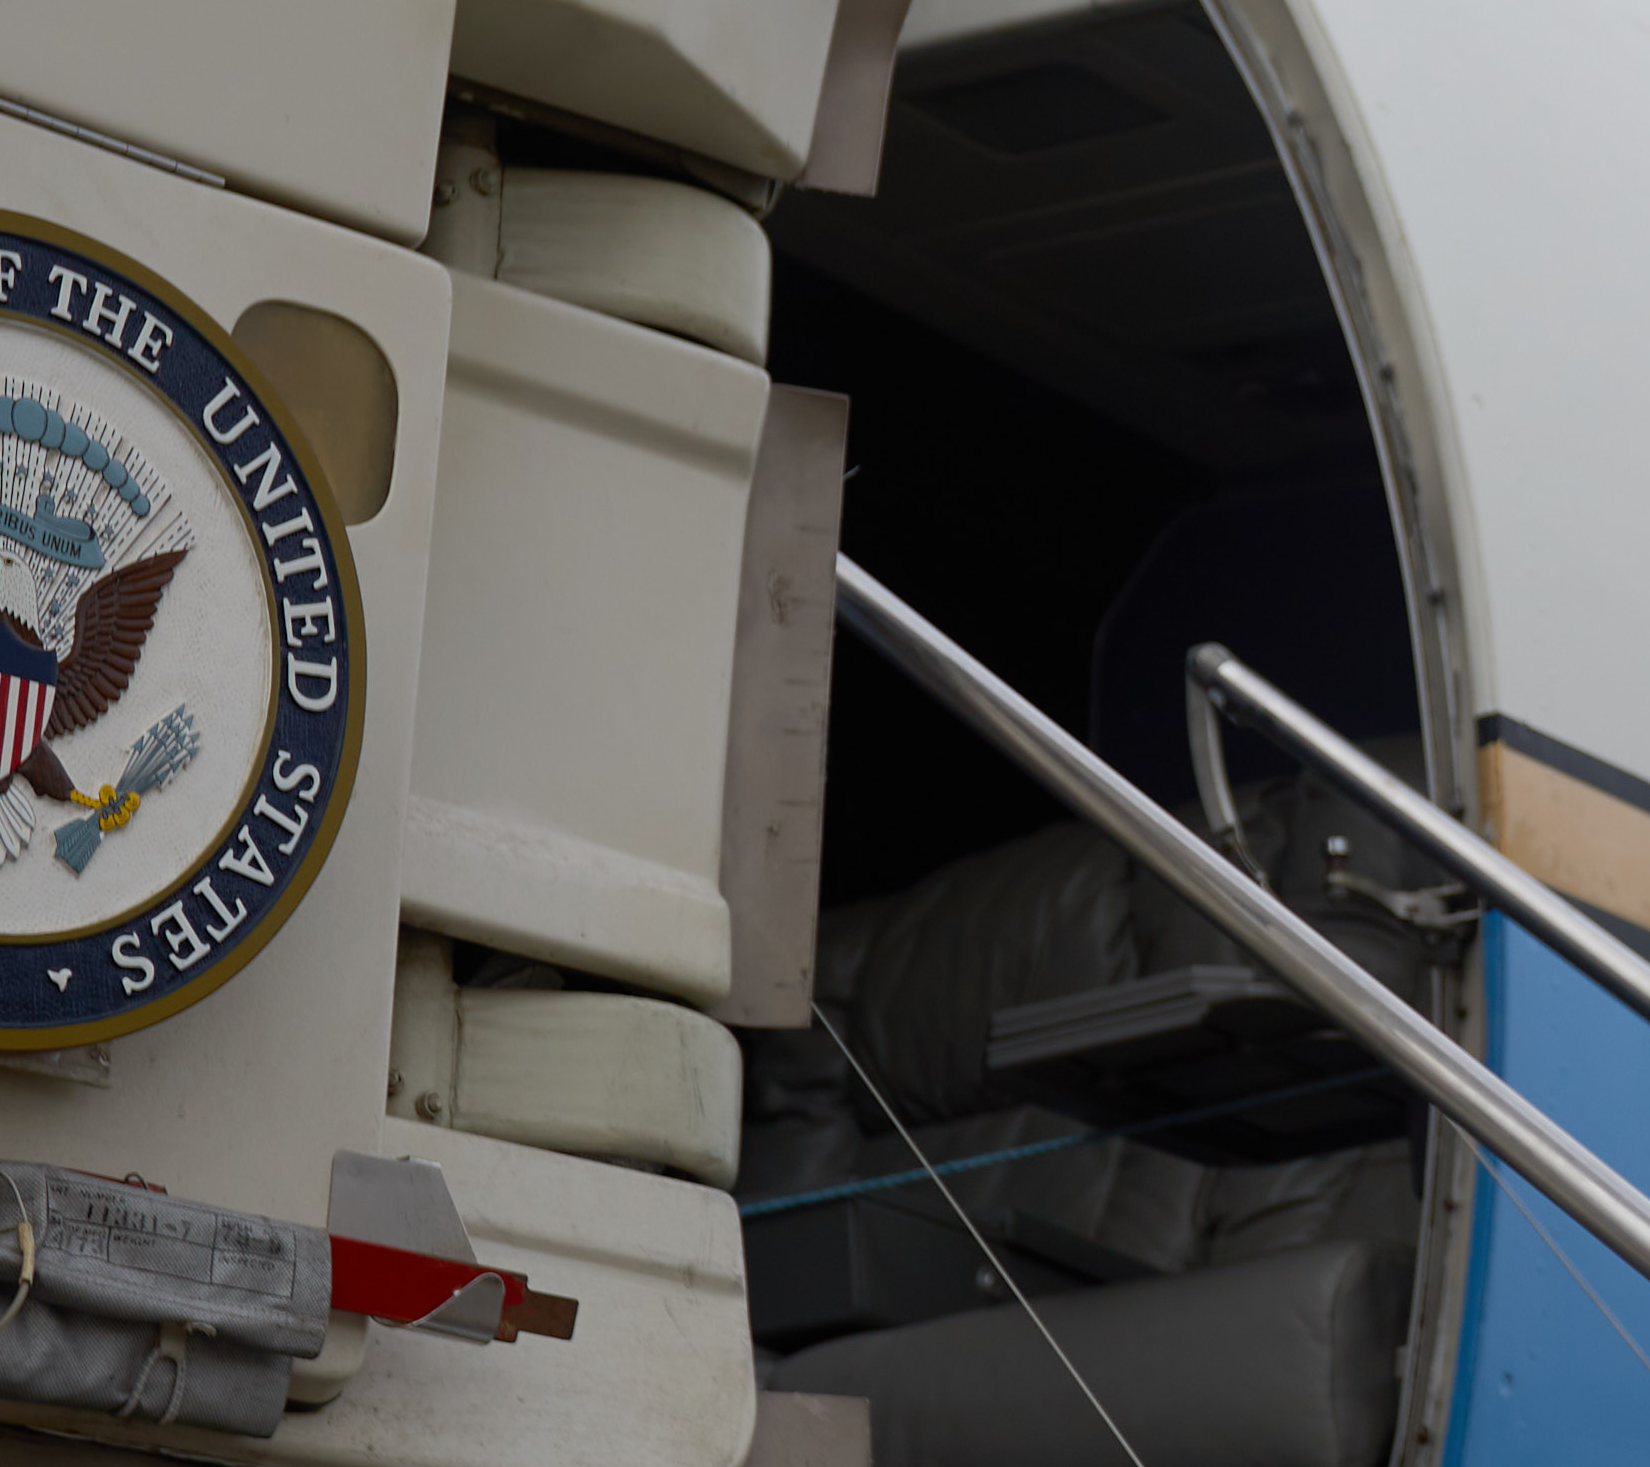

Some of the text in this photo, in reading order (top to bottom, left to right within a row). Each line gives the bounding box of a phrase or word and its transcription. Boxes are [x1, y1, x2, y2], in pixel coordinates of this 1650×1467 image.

[47, 263, 176, 376] THE
[41, 533, 82, 560] UNUM
[200, 377, 340, 714] UNITED
[110, 750, 323, 997] STATES
